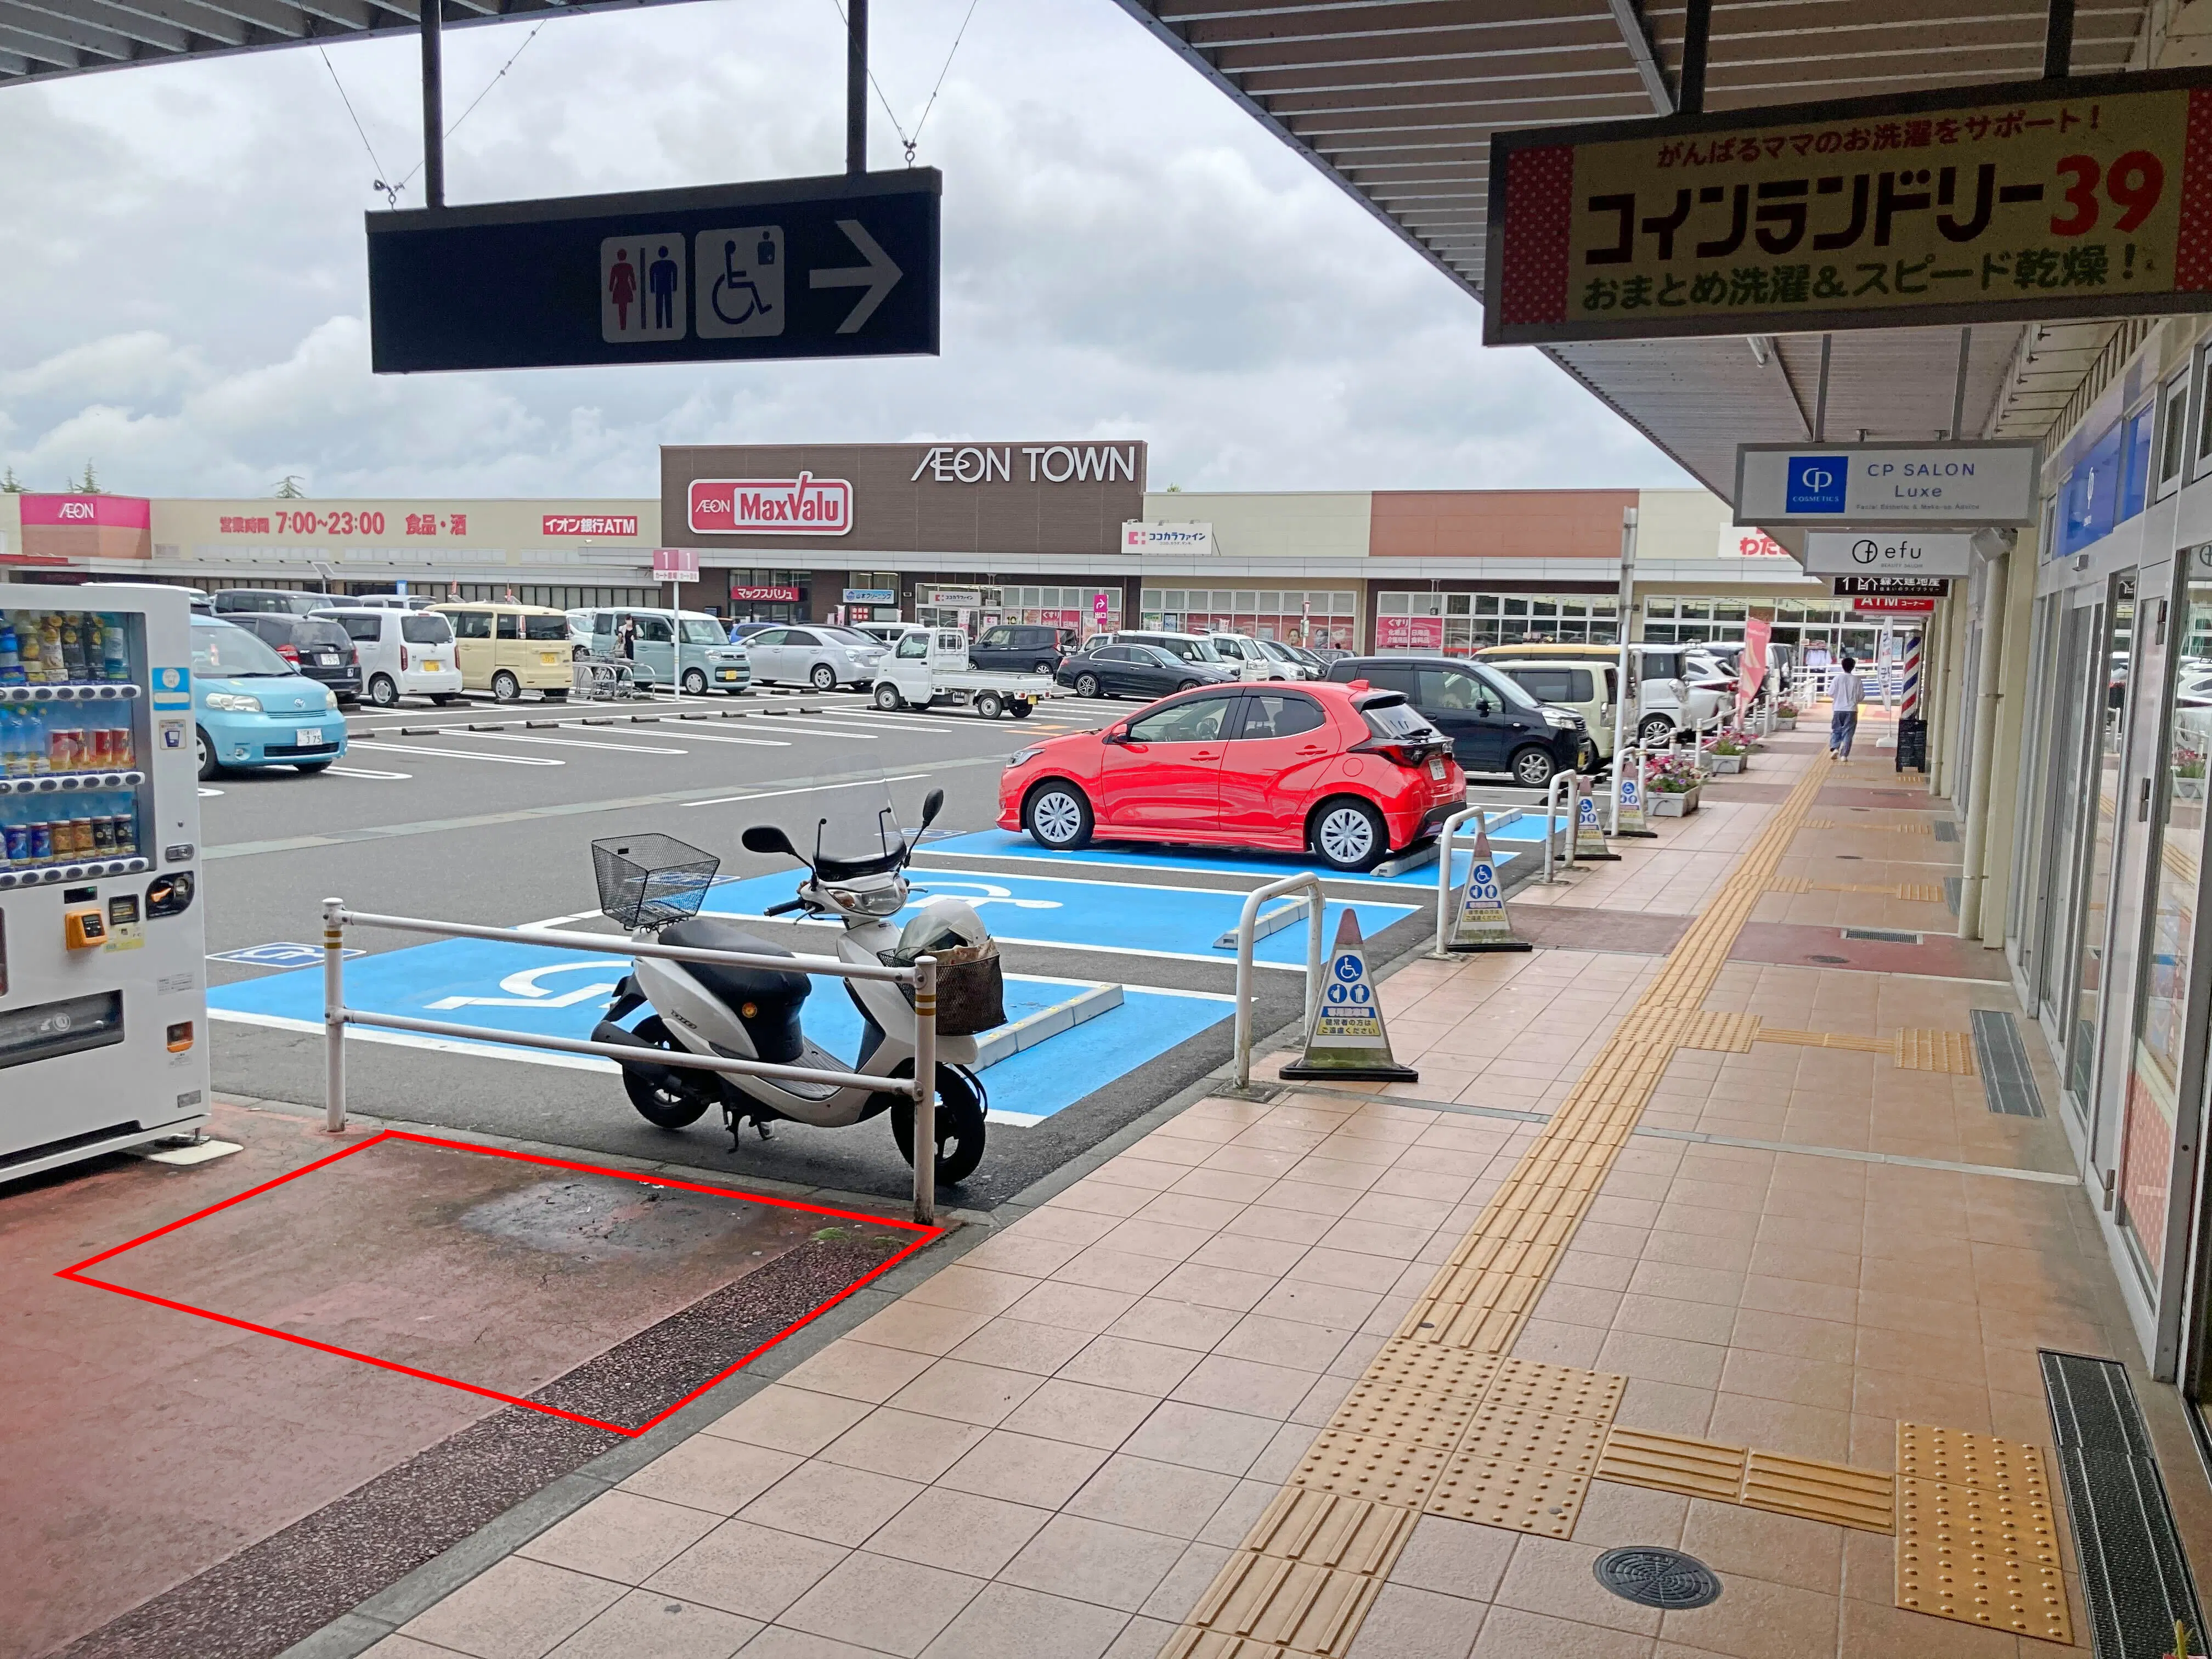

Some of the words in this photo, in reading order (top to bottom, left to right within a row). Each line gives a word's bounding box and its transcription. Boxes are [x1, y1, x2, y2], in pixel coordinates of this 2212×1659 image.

[1022, 445, 1135, 482] TOWN
[1867, 464, 1894, 477] CP
[1904, 462, 1976, 477] SALON
[740, 475, 838, 521] MaxValu
[1894, 484, 1943, 498] Luxe
[219, 516, 269, 534] 営業時間
[545, 518, 635, 534] イオン銀行ATM
[1149, 532, 1206, 541] ココカラファイン
[1885, 540, 1921, 558] efu
[662, 551, 669, 569] 1
[686, 552, 691, 569] 1
[737, 588, 793, 600] マックスバリュ
[1325, 1018, 1372, 1026] 健常者の方は
